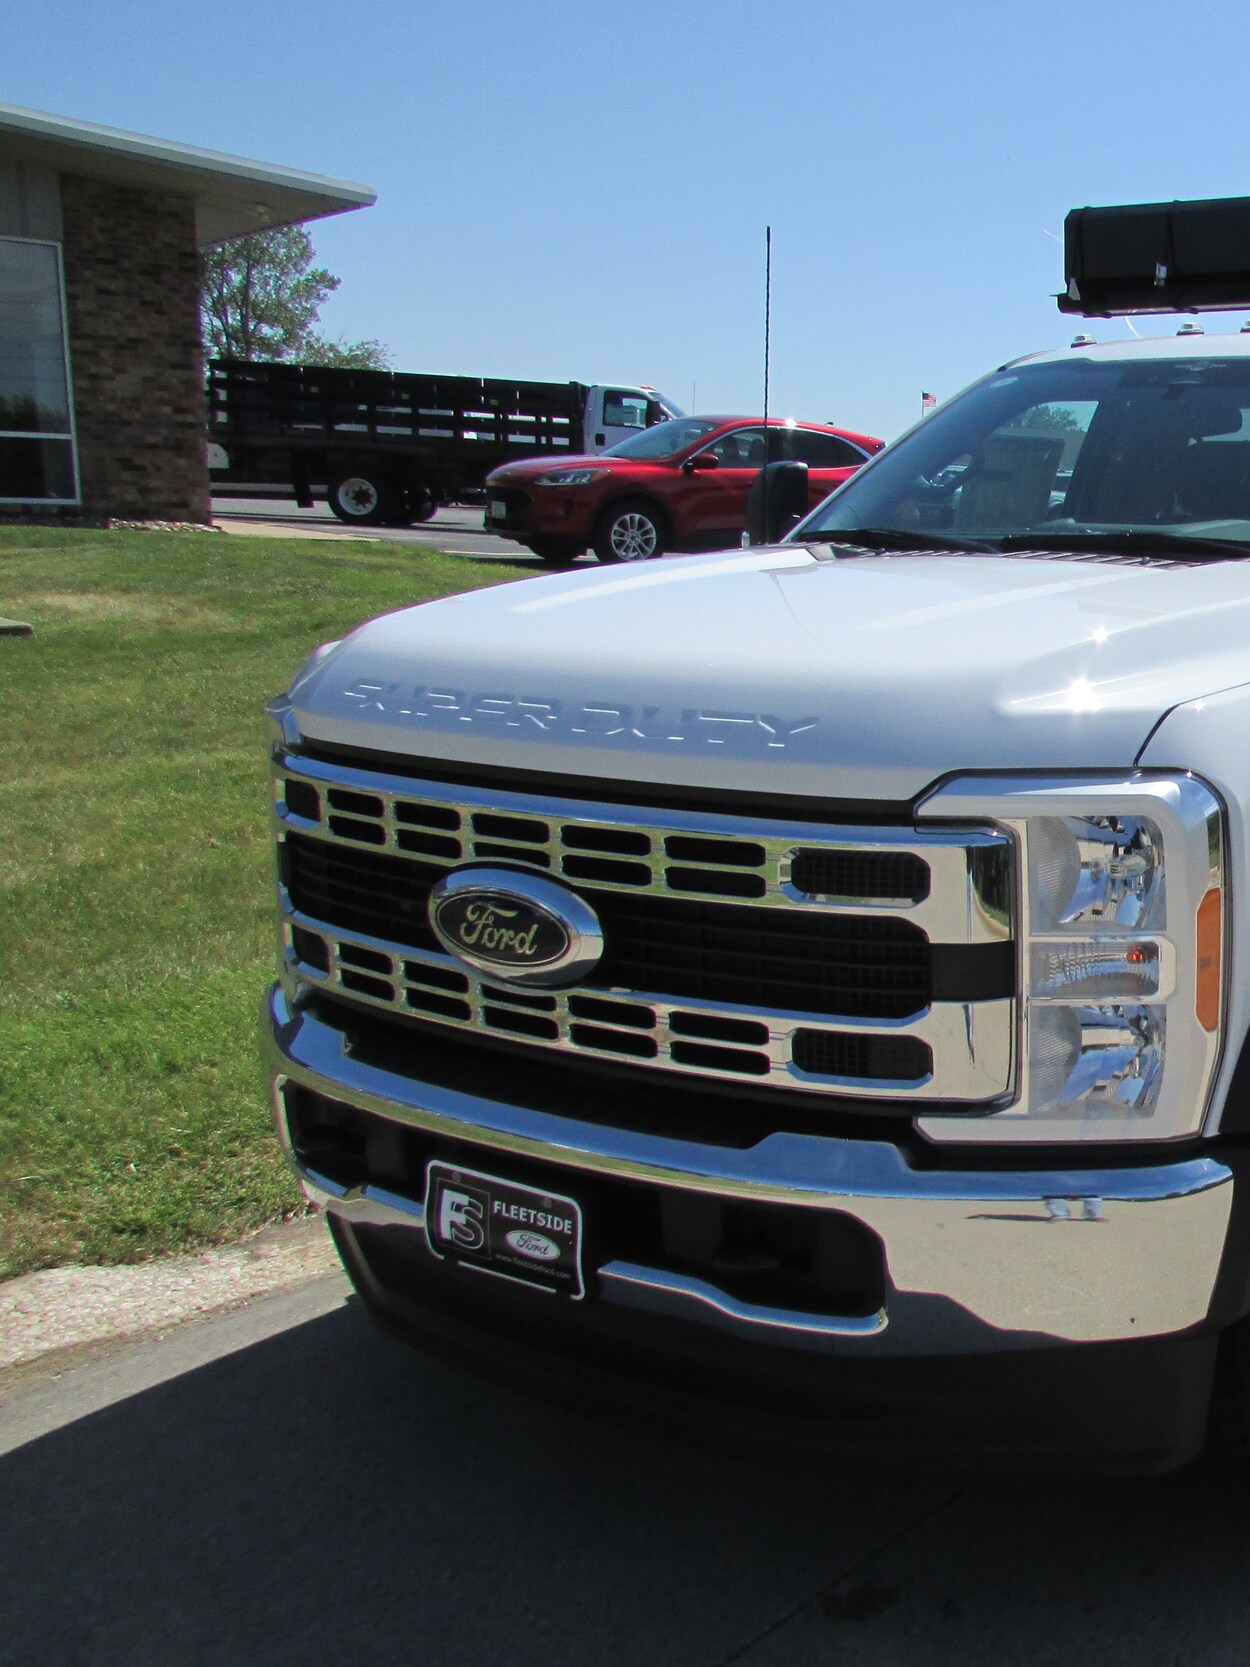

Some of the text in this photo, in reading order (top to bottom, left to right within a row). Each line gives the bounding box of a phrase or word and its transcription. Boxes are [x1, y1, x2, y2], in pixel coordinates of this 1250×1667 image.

[343, 677, 820, 748] SUPER DUTY
[459, 901, 539, 956] Ford
[493, 1200, 572, 1234] FLEETSIDE
[516, 1232, 550, 1256] Ford
